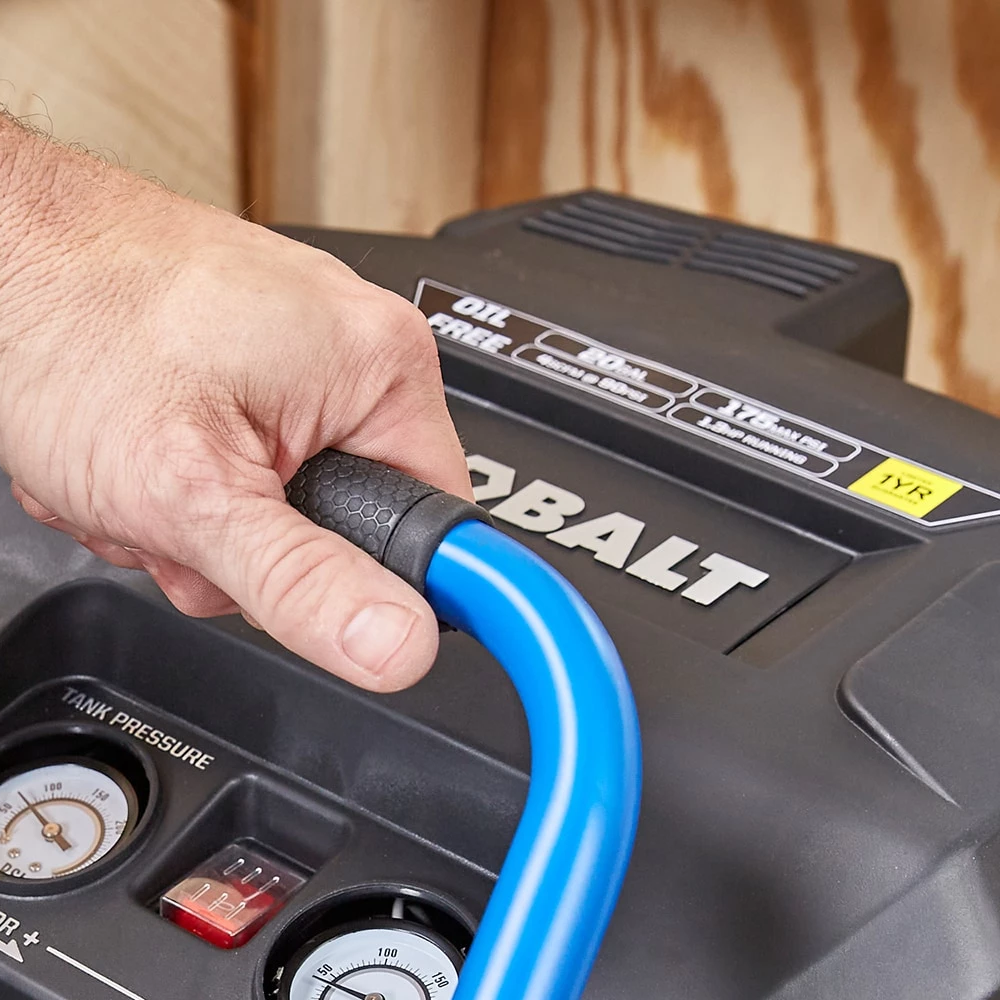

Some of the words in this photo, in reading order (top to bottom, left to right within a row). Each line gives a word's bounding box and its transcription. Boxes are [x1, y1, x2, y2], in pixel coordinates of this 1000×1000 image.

[451, 296, 511, 328] OIL
[427, 312, 512, 353] FREE
[742, 434, 808, 465] RUNNING
[466, 453, 770, 606] OBALT
[61, 687, 113, 720] TANK
[109, 711, 215, 770] PRESSURE
[44, 782, 63, 792] 100
[91, 788, 110, 801] 150
[378, 947, 398, 958] 100
[317, 963, 333, 976] 50
[431, 972, 450, 988] 150
